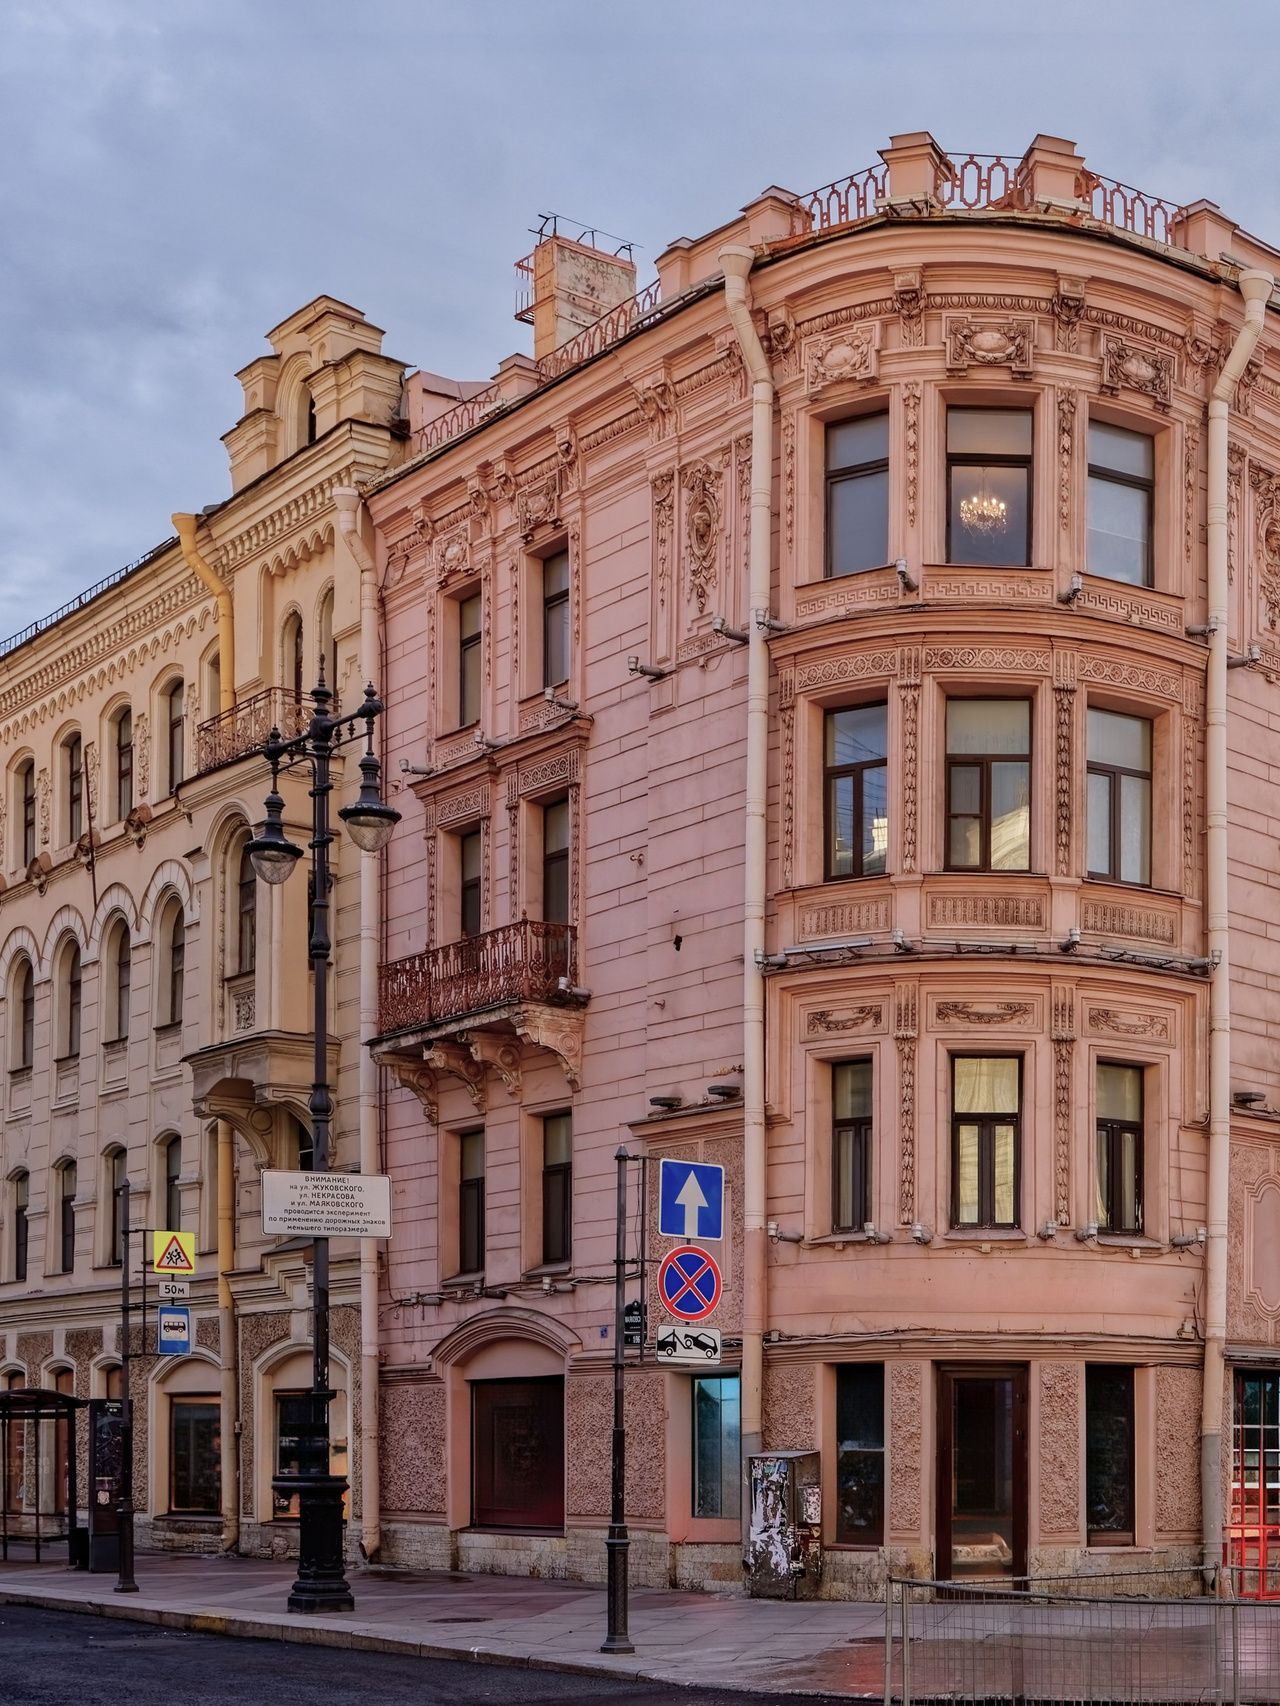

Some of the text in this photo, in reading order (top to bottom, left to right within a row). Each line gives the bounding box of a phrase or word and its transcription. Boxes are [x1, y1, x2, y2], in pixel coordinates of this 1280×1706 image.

[304, 1175, 350, 1184] ВНИМАНИЕ!
[311, 1192, 355, 1200] НЕКРАСОВА
[310, 1200, 364, 1209] МАЯКОВСКОГО
[283, 1208, 371, 1218] проводится эксперимент
[279, 1216, 324, 1224] применению
[164, 1284, 185, 1295] 50м
